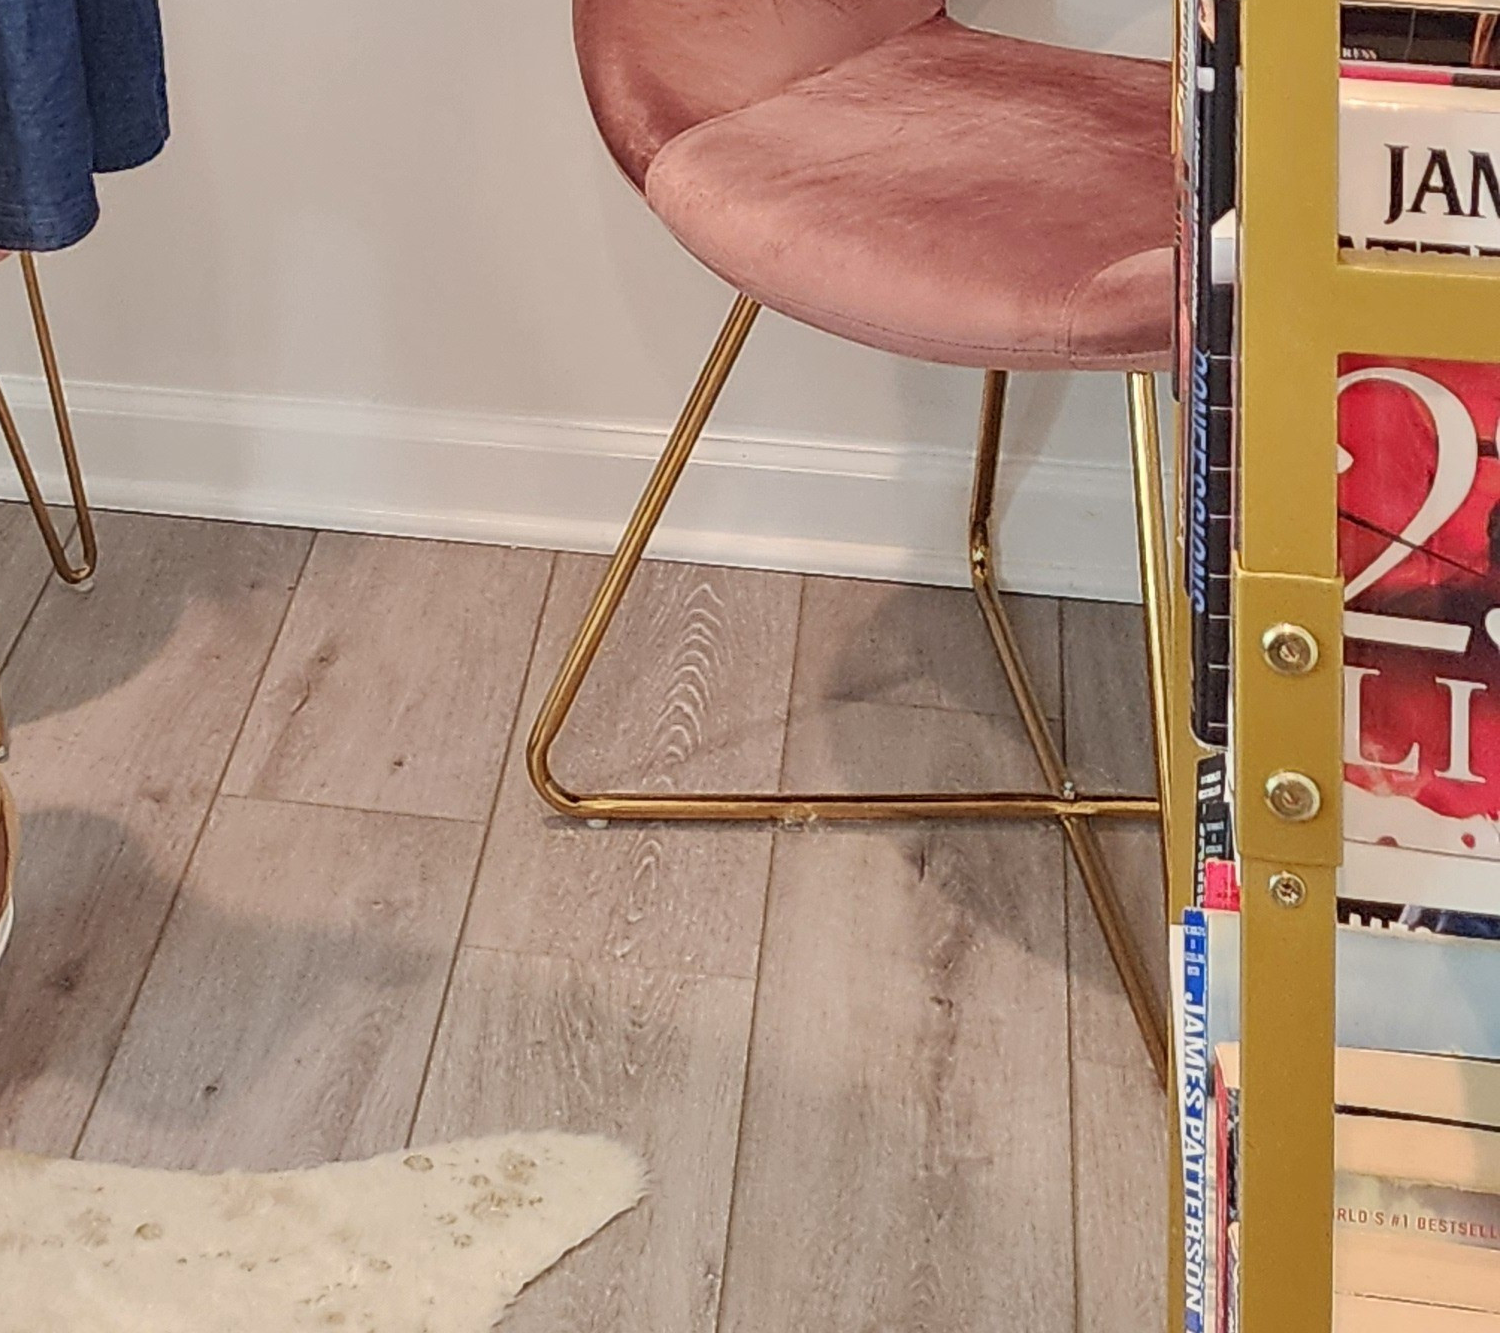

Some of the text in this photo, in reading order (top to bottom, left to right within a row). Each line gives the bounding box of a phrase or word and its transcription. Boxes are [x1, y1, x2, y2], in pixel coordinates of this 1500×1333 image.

[1183, 990, 1206, 1111] JAMES
[1183, 1114, 1206, 1316] PATTERSON
[1416, 1216, 1500, 1240] BESTSELL
